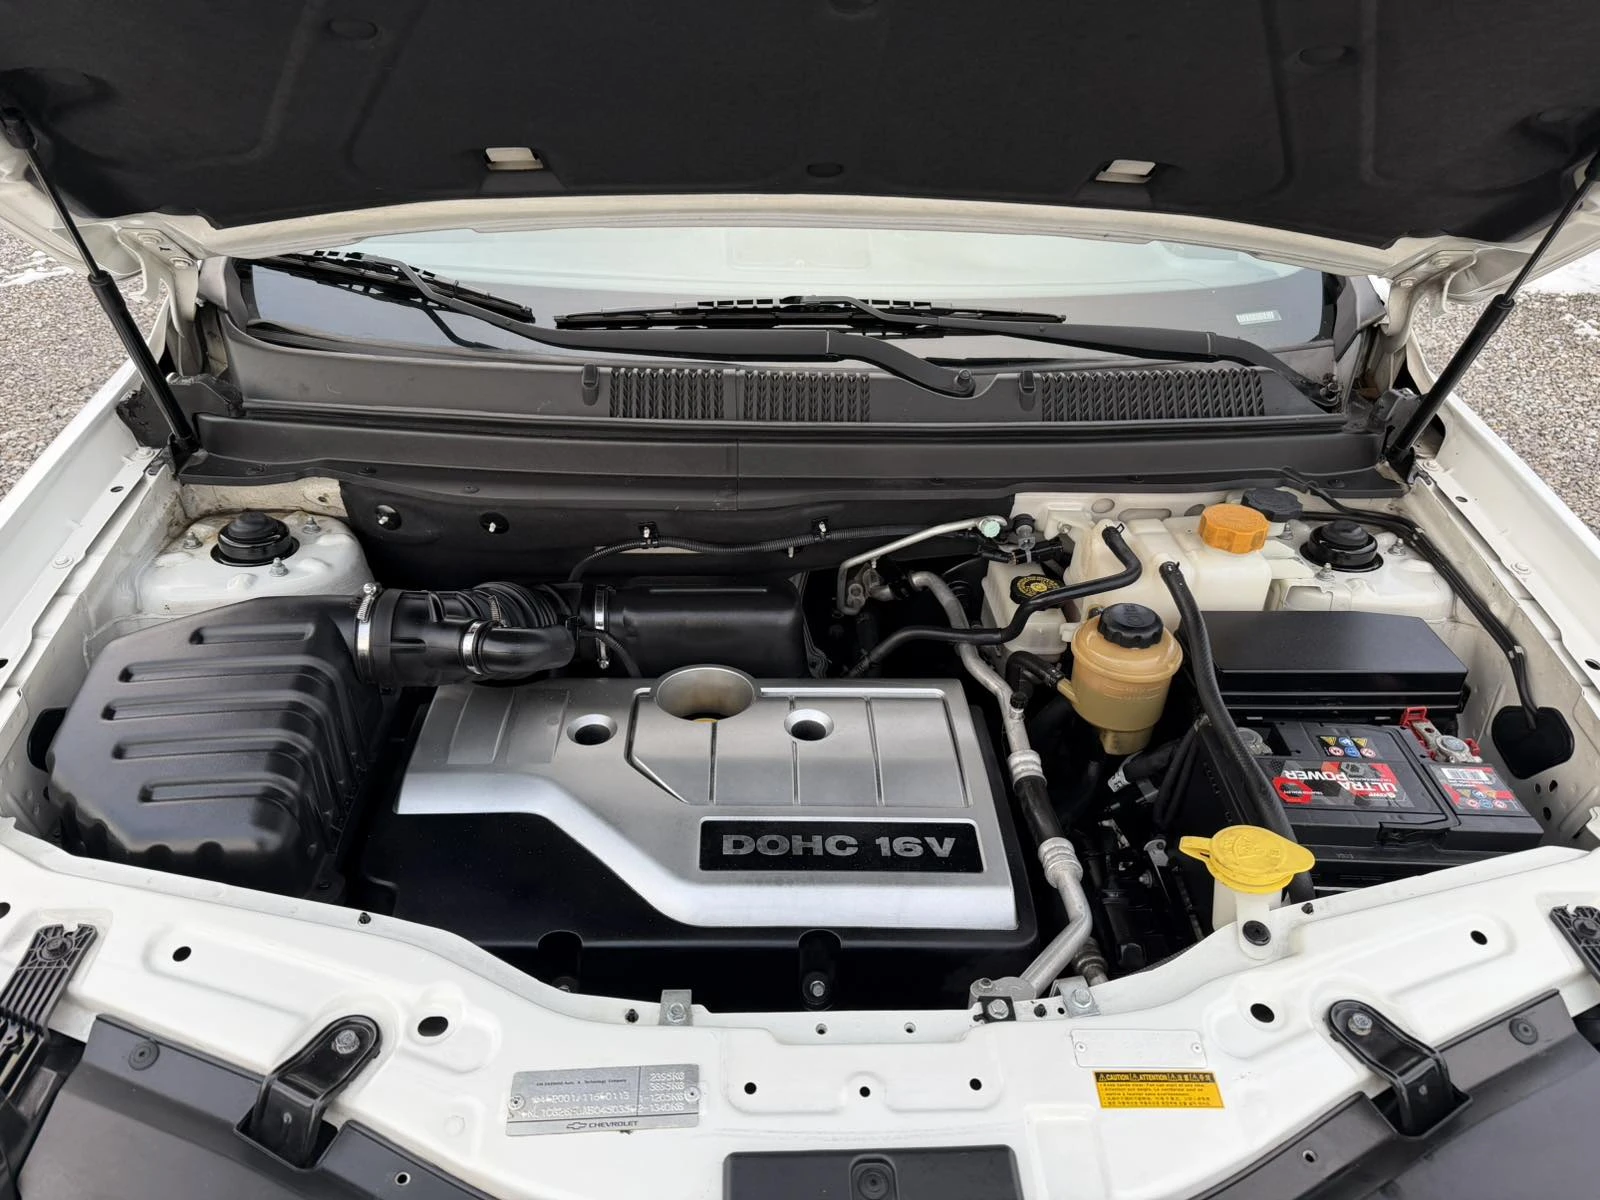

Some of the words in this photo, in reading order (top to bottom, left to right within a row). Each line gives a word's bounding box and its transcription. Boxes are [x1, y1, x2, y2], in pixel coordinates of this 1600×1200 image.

[1282, 769, 1350, 781] POWER
[1338, 781, 1398, 792] ULTRA
[722, 834, 859, 856] DOHC
[875, 836, 956, 858] 16V
[589, 1120, 639, 1128] CHEVROLET
